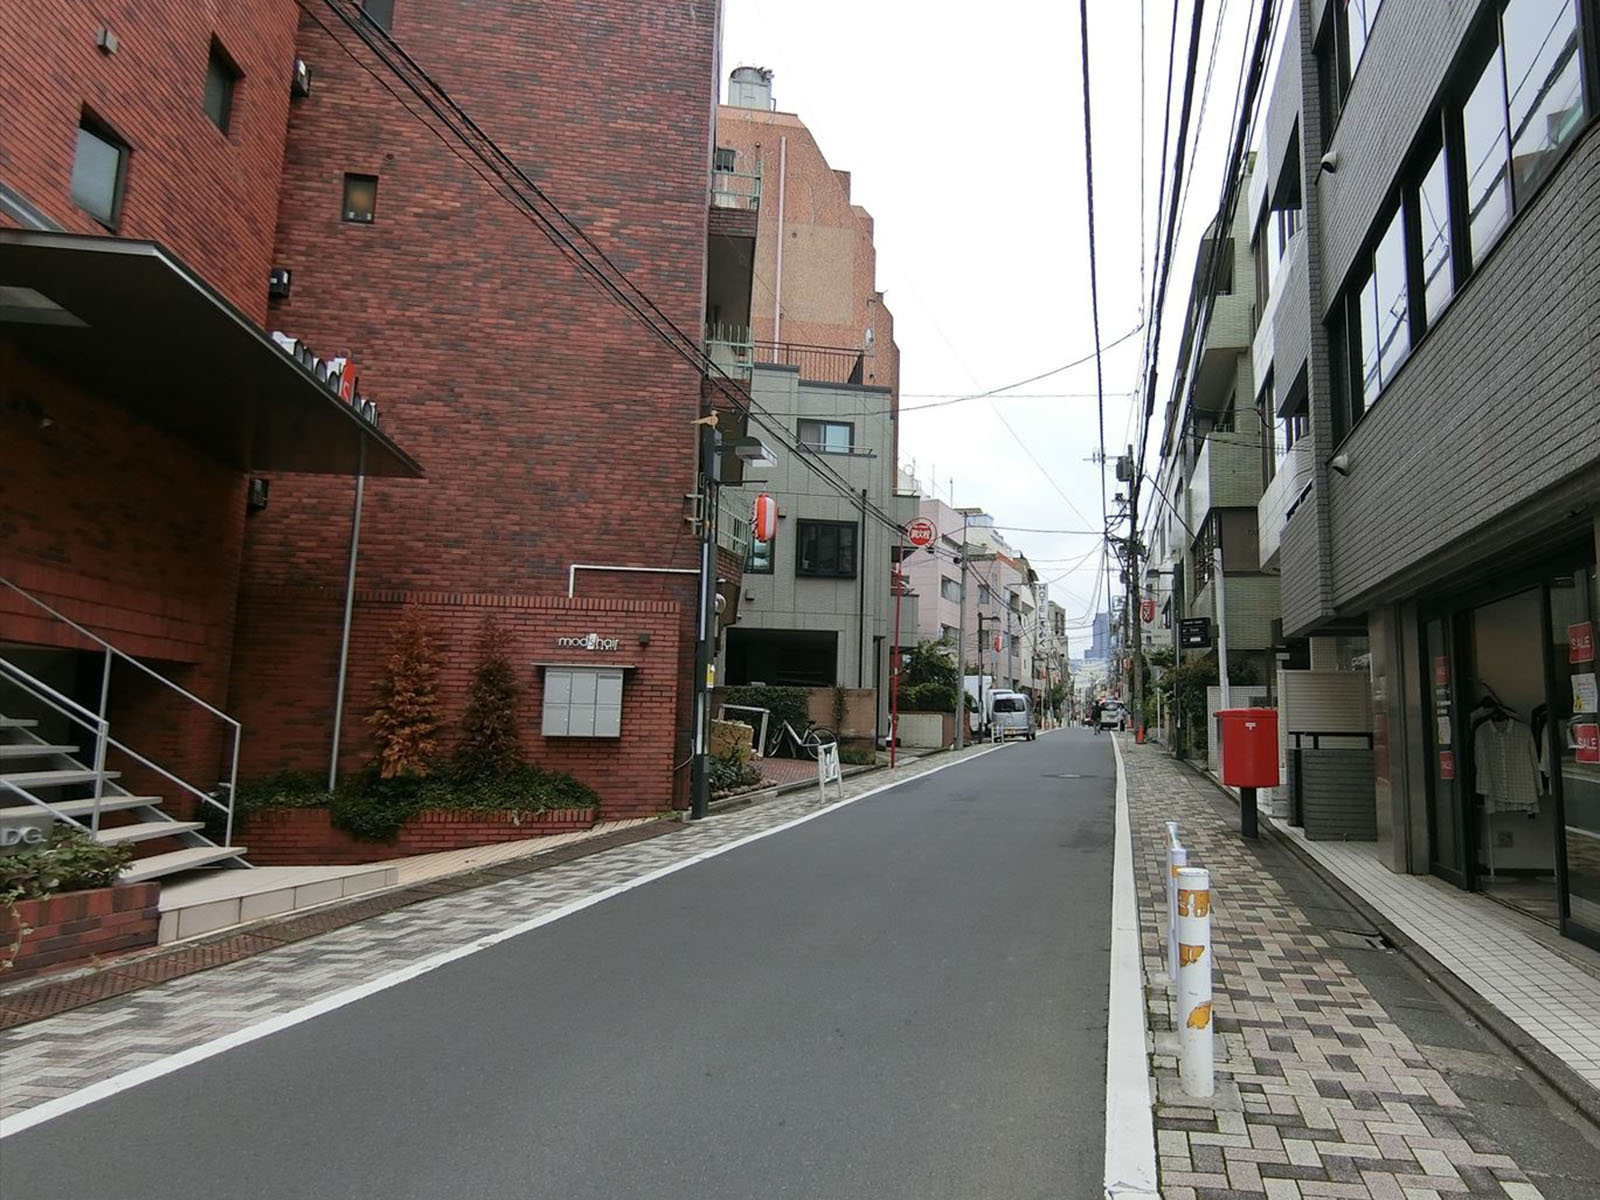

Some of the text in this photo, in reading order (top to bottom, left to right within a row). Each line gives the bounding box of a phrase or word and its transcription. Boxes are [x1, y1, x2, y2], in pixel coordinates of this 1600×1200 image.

[1038, 584, 1046, 619] HOTEL
[1571, 636, 1590, 650] SALE
[1577, 737, 1598, 750] SALE
